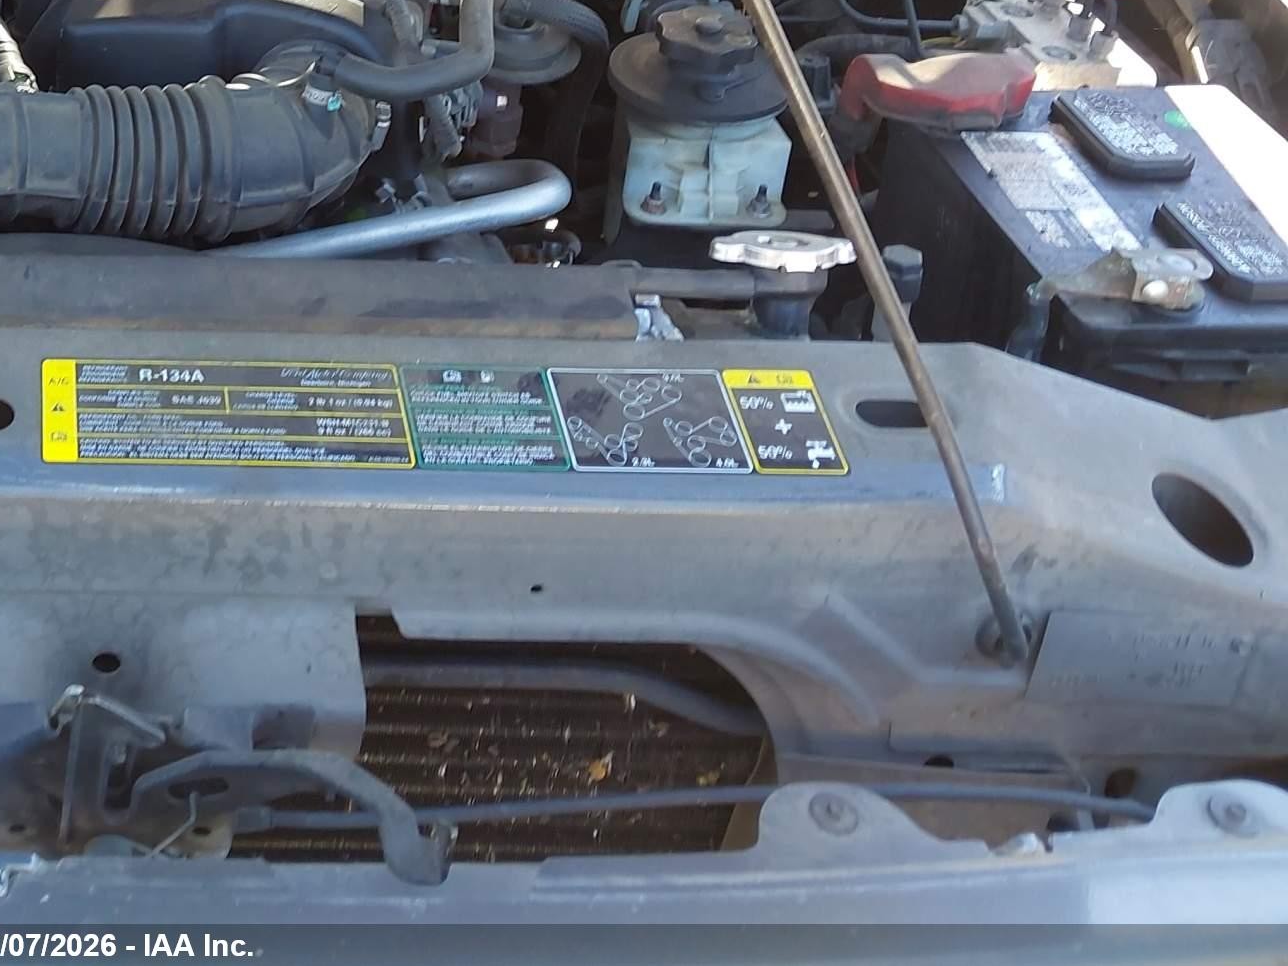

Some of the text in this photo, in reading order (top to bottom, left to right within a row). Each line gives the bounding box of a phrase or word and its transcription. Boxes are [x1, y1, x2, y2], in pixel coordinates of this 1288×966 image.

[139, 368, 205, 383] R-134A
[739, 396, 775, 410] 50%
[757, 445, 793, 460] 50%
